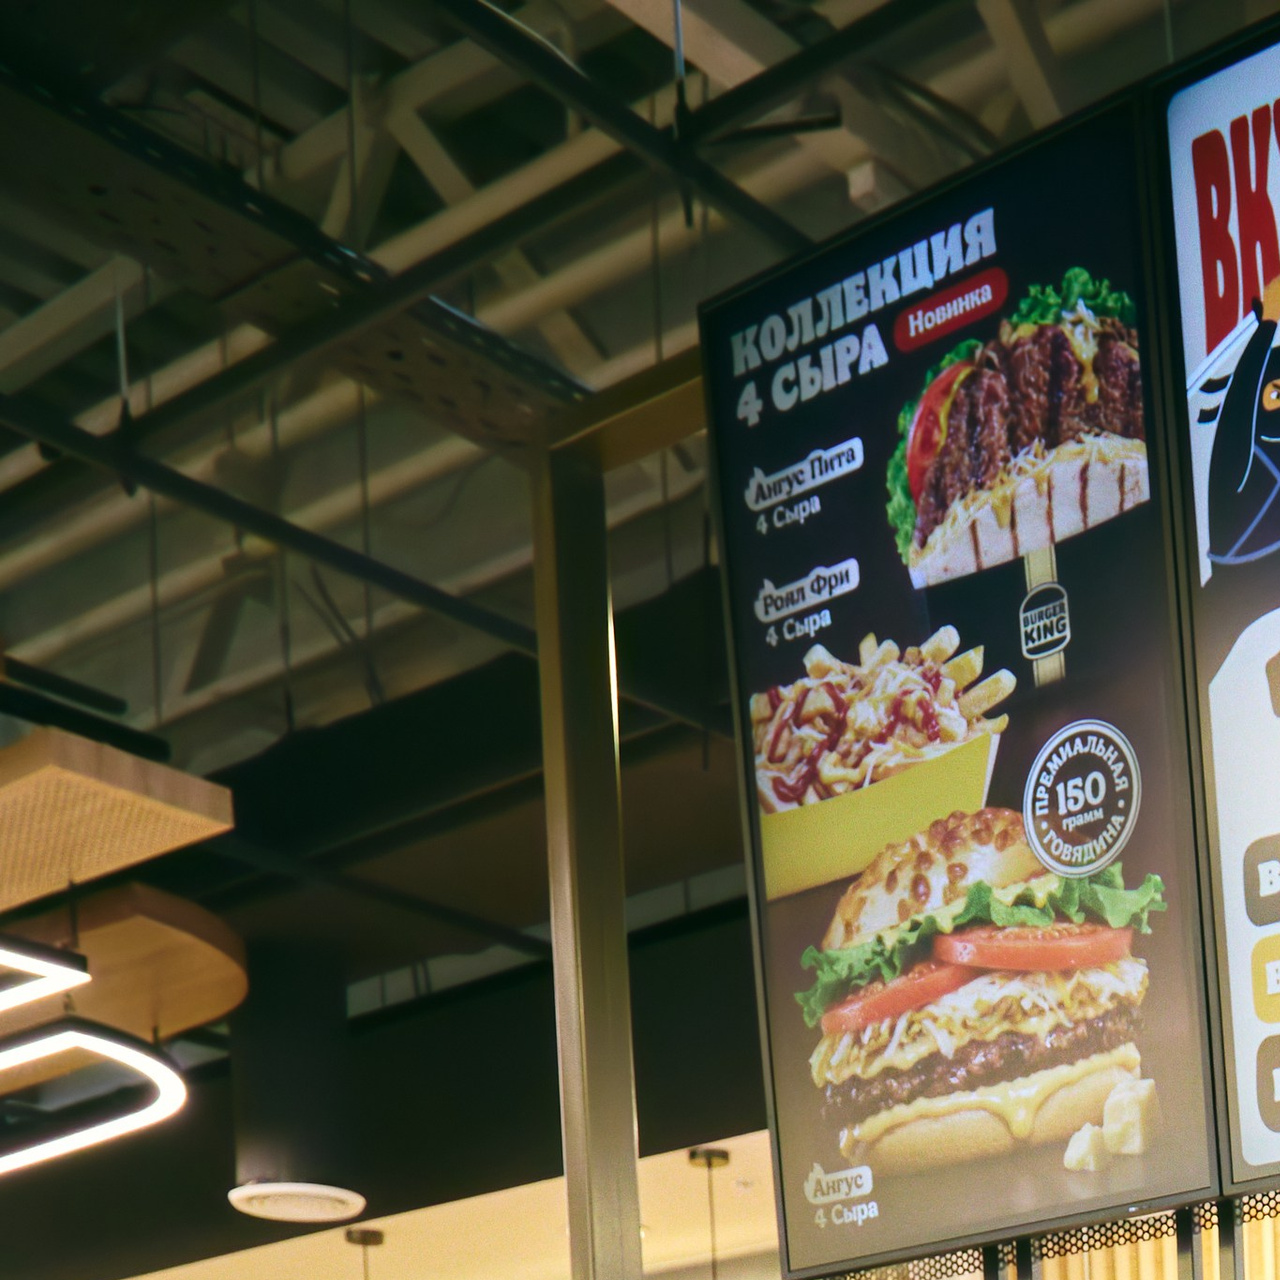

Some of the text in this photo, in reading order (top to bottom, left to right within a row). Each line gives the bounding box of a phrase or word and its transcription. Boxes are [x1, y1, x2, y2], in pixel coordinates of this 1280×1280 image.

[730, 207, 998, 378] КОЛЛЕКЦИЯ
[908, 284, 993, 337] Новинка
[737, 324, 889, 427] 4 СЫРА
[755, 447, 856, 504] Ангус Пита
[756, 495, 821, 535] 4 Сыра
[810, 567, 851, 596] Фри
[765, 608, 832, 647] 4 Сыра
[1023, 602, 1066, 628] BURGER
[1024, 615, 1067, 646] KING
[1035, 735, 1129, 816] ПРЕМИАЛЬНАЯ
[1056, 771, 1107, 816] 150
[1043, 814, 1125, 864] ГОВЯДИНА
[1062, 807, 1104, 832] грамм
[813, 1174, 864, 1198] Ангус
[815, 1201, 879, 1228] 4 Сыра
